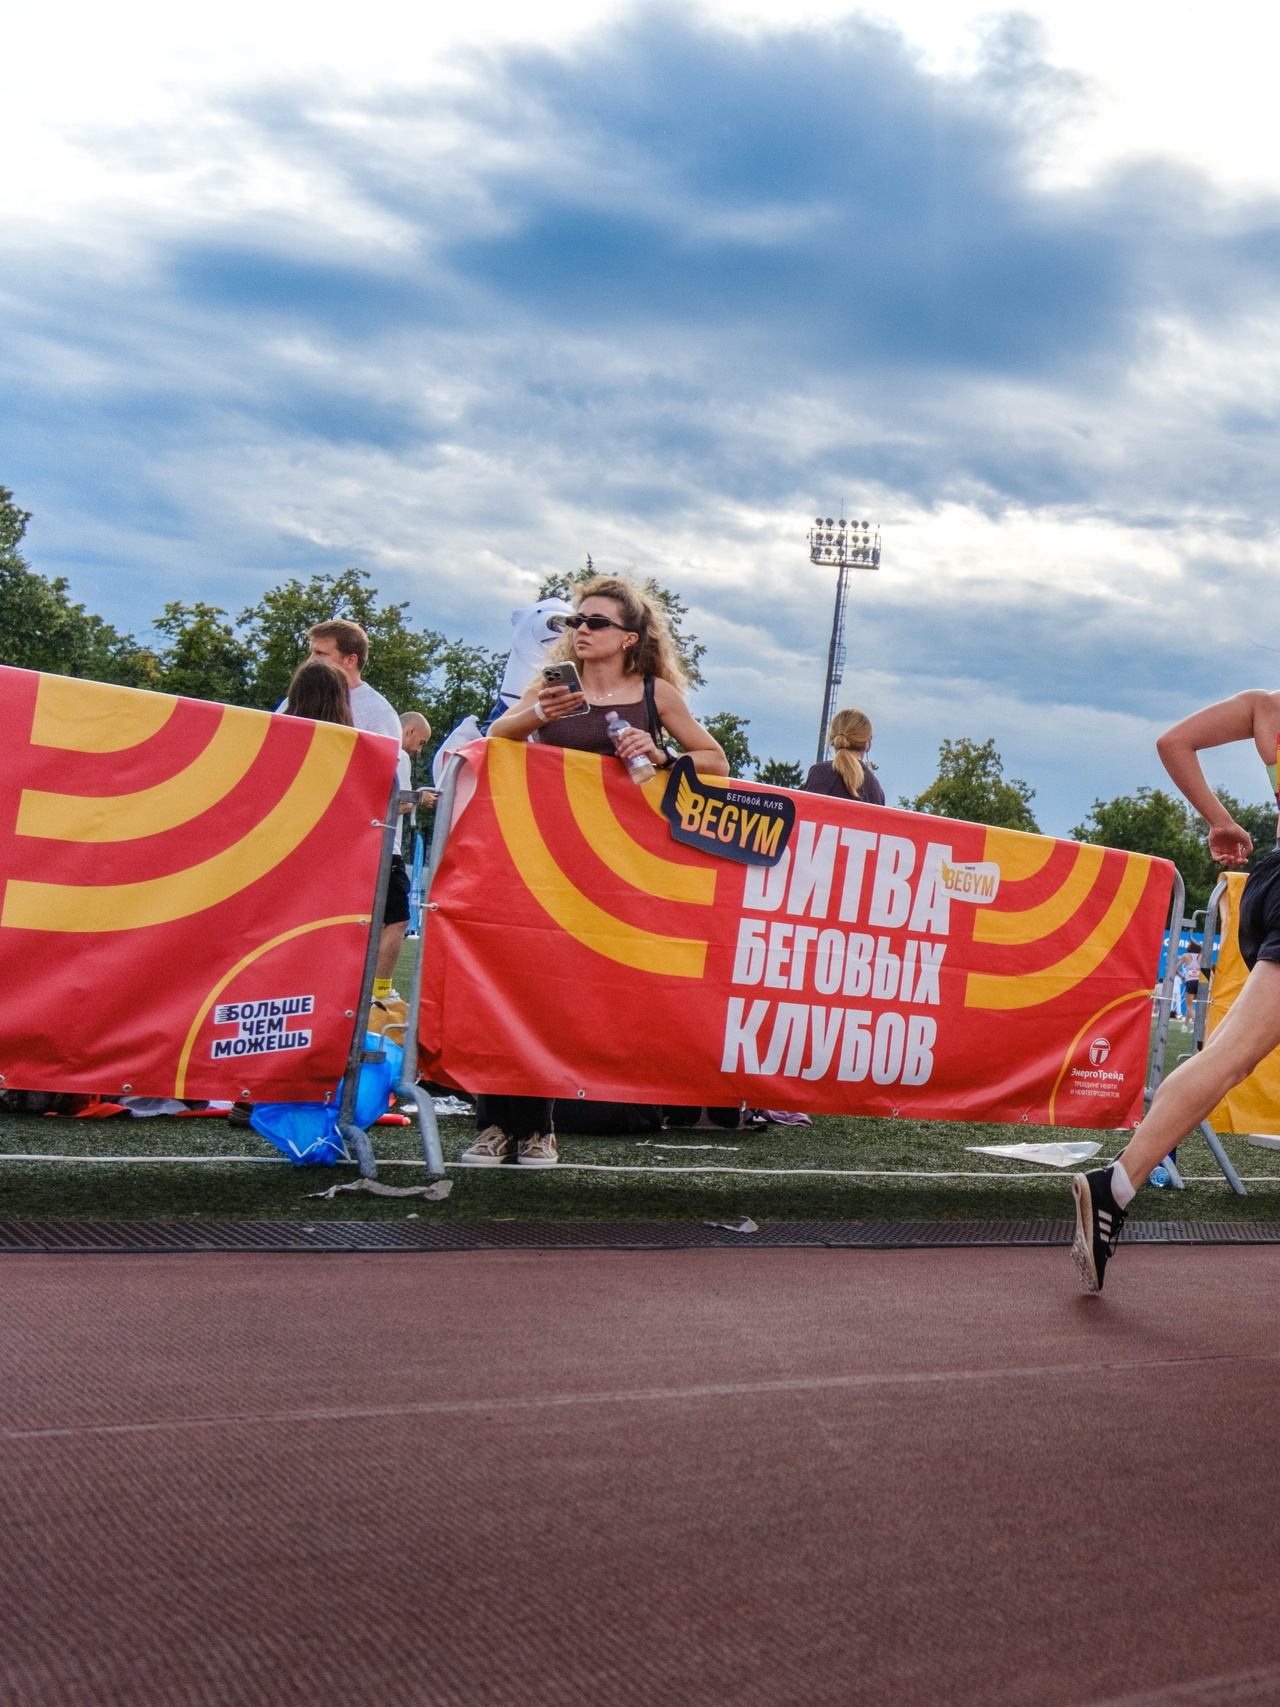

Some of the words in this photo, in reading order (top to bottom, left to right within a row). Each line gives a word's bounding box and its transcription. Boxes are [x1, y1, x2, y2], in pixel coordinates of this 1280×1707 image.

[727, 792, 761, 806] БЕГОВОЙ
[763, 799, 784, 810] КЛУБ
[679, 790, 785, 858] BEGYM
[943, 867, 995, 898] BEGYM
[731, 917, 948, 1006] БЕГОВЫХ
[218, 997, 312, 1023] БОЛЬШЕ
[241, 1017, 284, 1036] ЧЕМ
[214, 1031, 310, 1058] МОЖЕШЬ
[720, 996, 938, 1086] КЛУБОВ
[1070, 1067, 1125, 1083] ЭнергоТрейд
